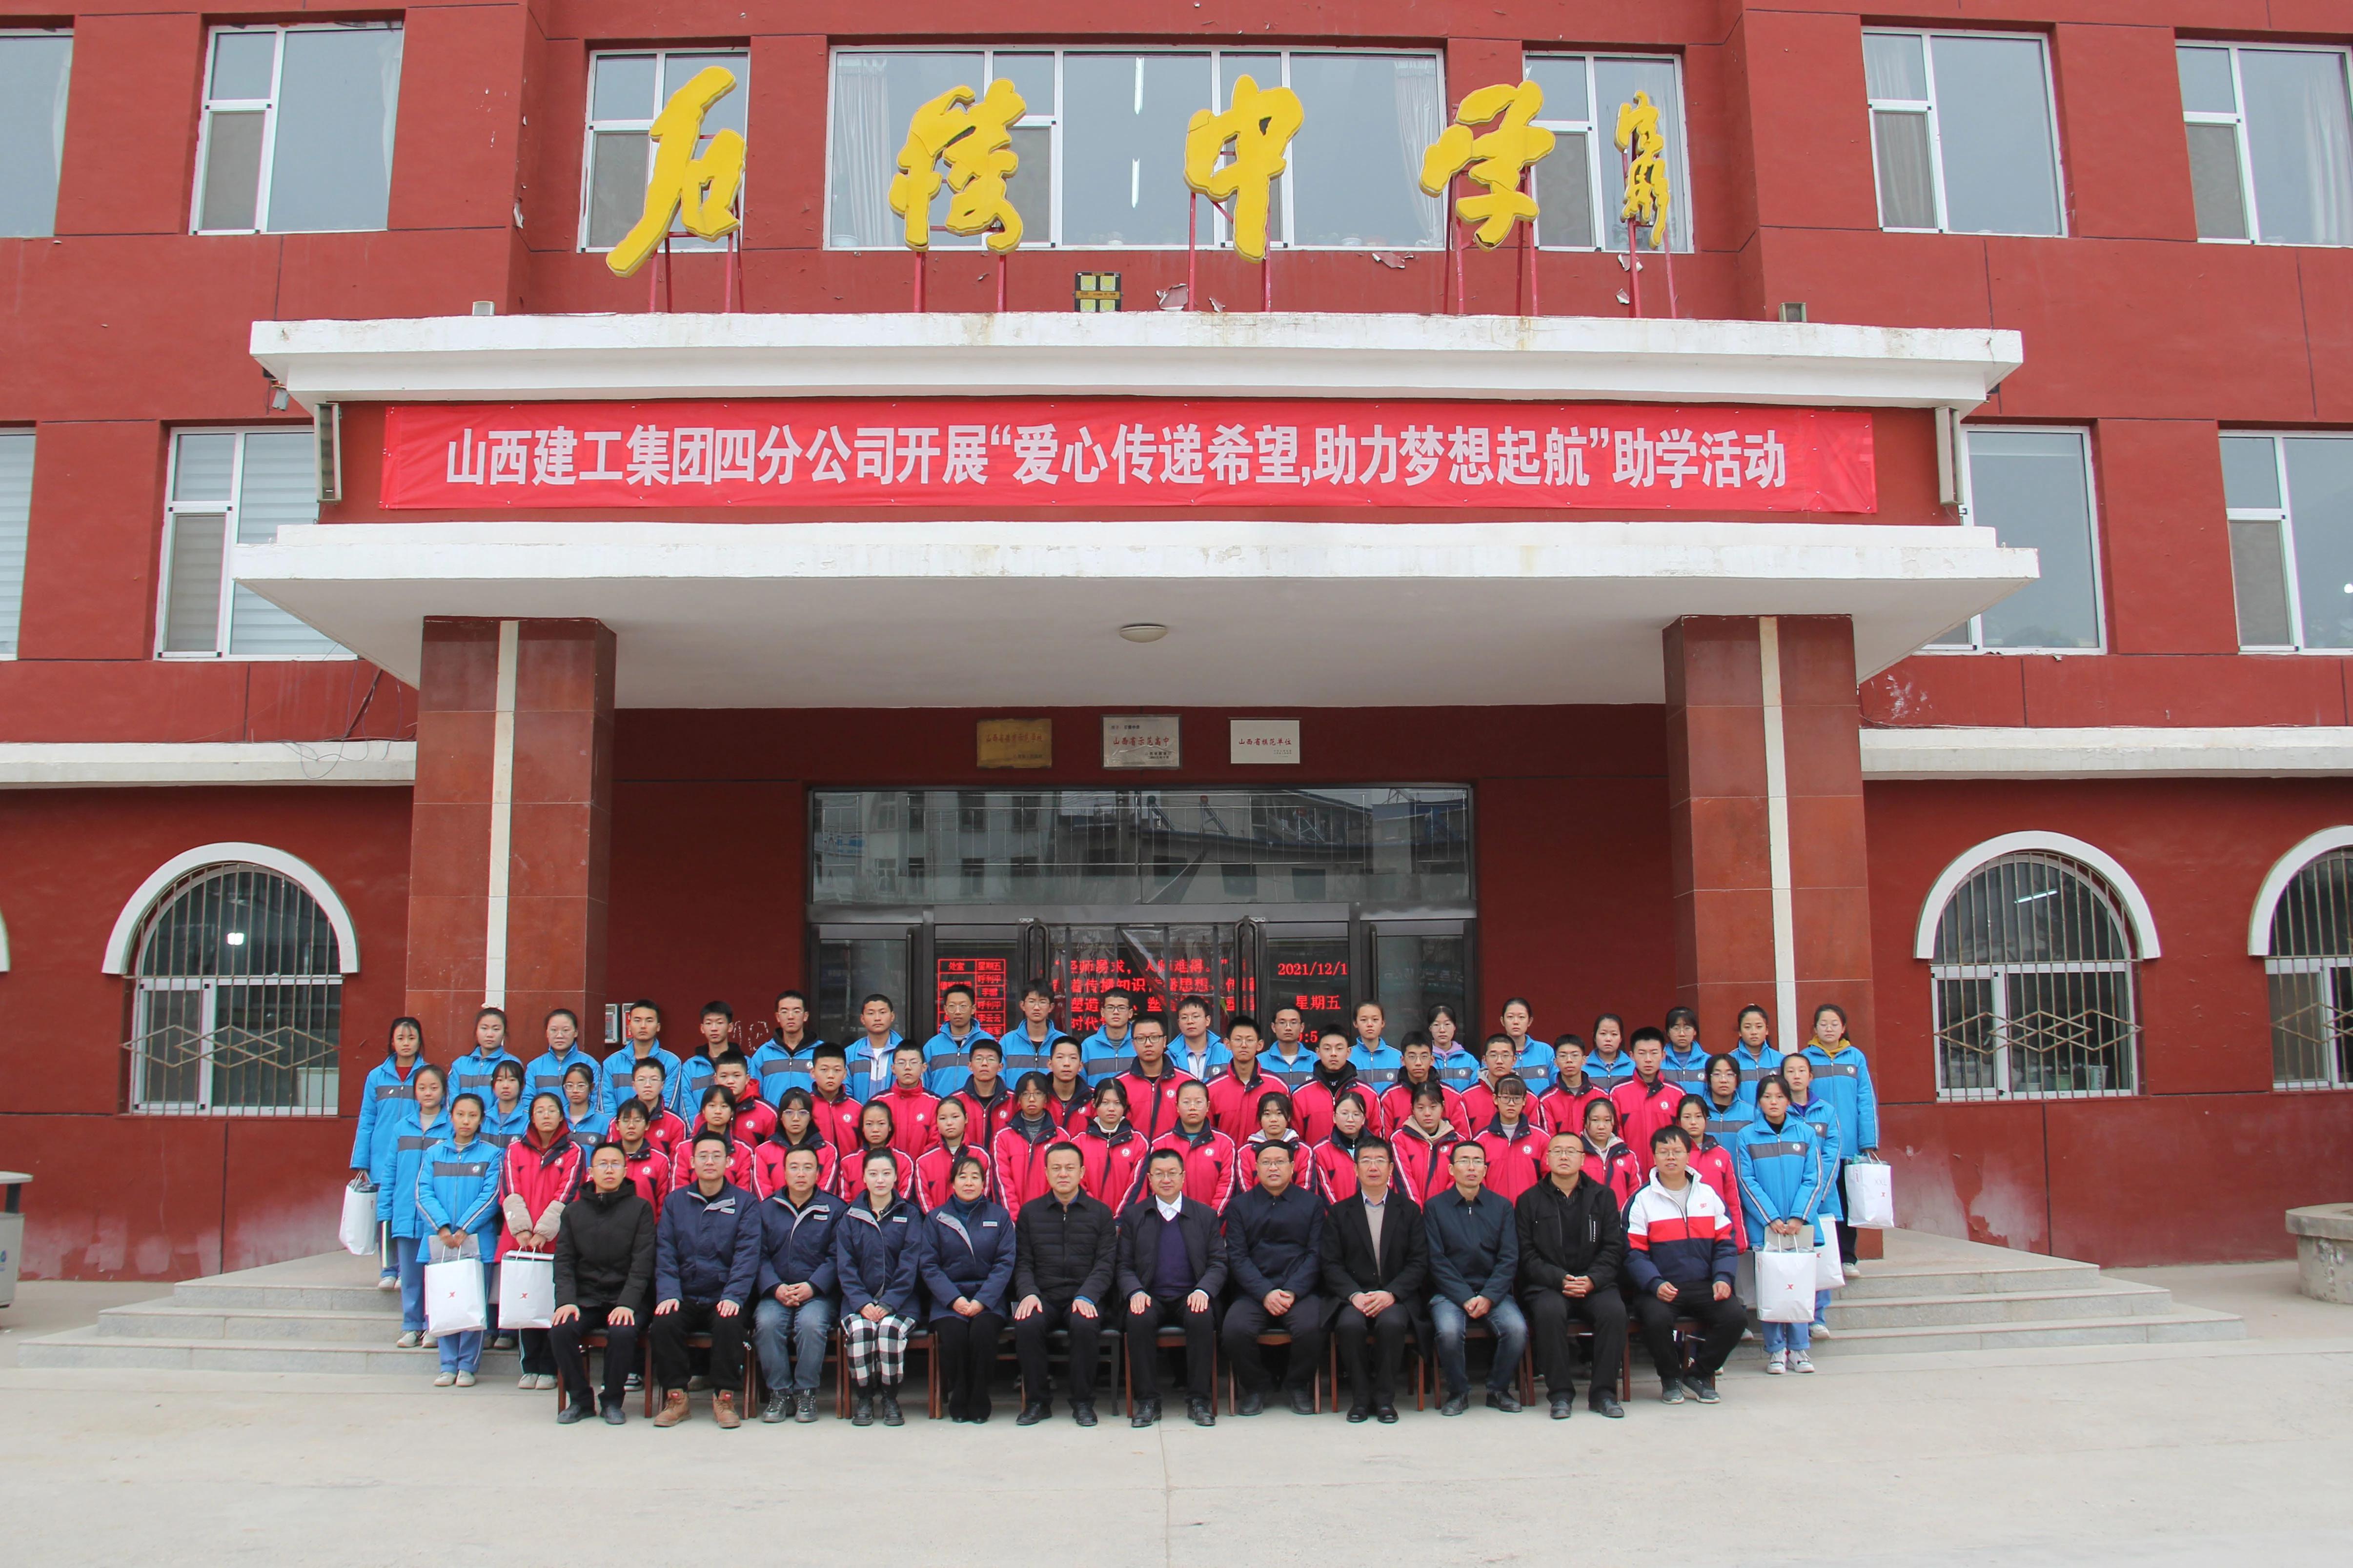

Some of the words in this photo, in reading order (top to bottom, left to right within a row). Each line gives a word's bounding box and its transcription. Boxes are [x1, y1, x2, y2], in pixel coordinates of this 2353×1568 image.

[1113, 736, 1170, 746] 山西省示范高中
[1238, 737, 1292, 746] 山西省模范单位
[977, 961, 1002, 971] 星期五
[1296, 995, 1341, 1010] 星期五
[977, 1014, 1001, 1023] 李云云
